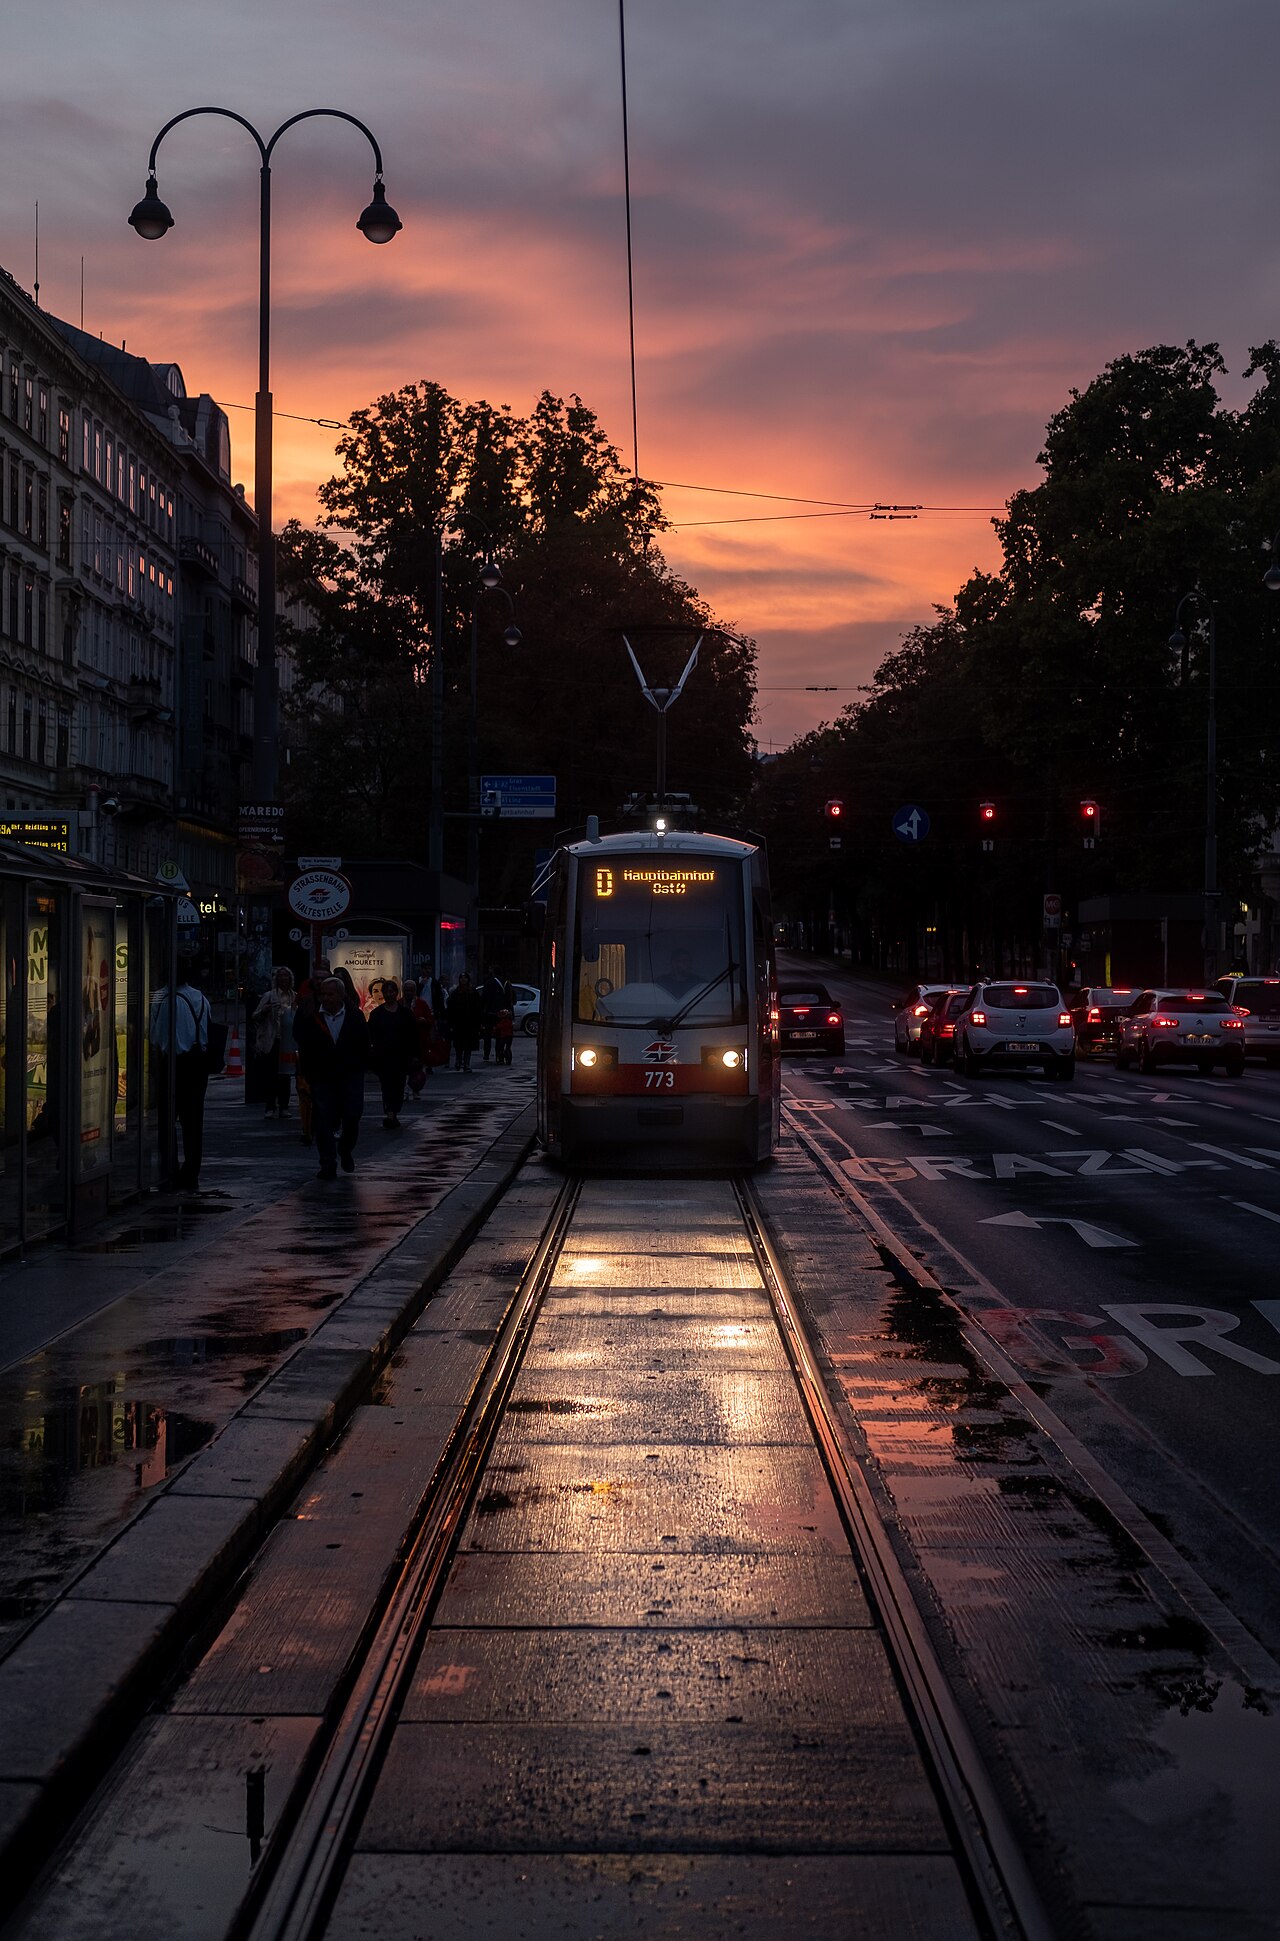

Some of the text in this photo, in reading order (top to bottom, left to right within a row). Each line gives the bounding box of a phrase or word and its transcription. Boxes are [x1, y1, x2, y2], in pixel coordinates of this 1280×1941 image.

[239, 806, 284, 817] MAREDO
[0, 824, 11, 835] 9A
[61, 825, 67, 835] 3
[165, 865, 174, 876] H
[293, 874, 346, 894] STRASSENBAHN
[596, 868, 715, 897] D Hauptbahnhof
[652, 882, 675, 894] Ost
[178, 900, 189, 909] US
[200, 901, 216, 914] tel
[295, 901, 343, 918] HALTESTELLE
[291, 930, 301, 939] 71
[339, 930, 346, 939] D
[304, 939, 311, 947] 2
[644, 1071, 674, 1088] 773
[782, 1094, 994, 1111] GRAZ
[839, 1150, 1154, 1183] GRAZ
[970, 1300, 1280, 1379] GR
